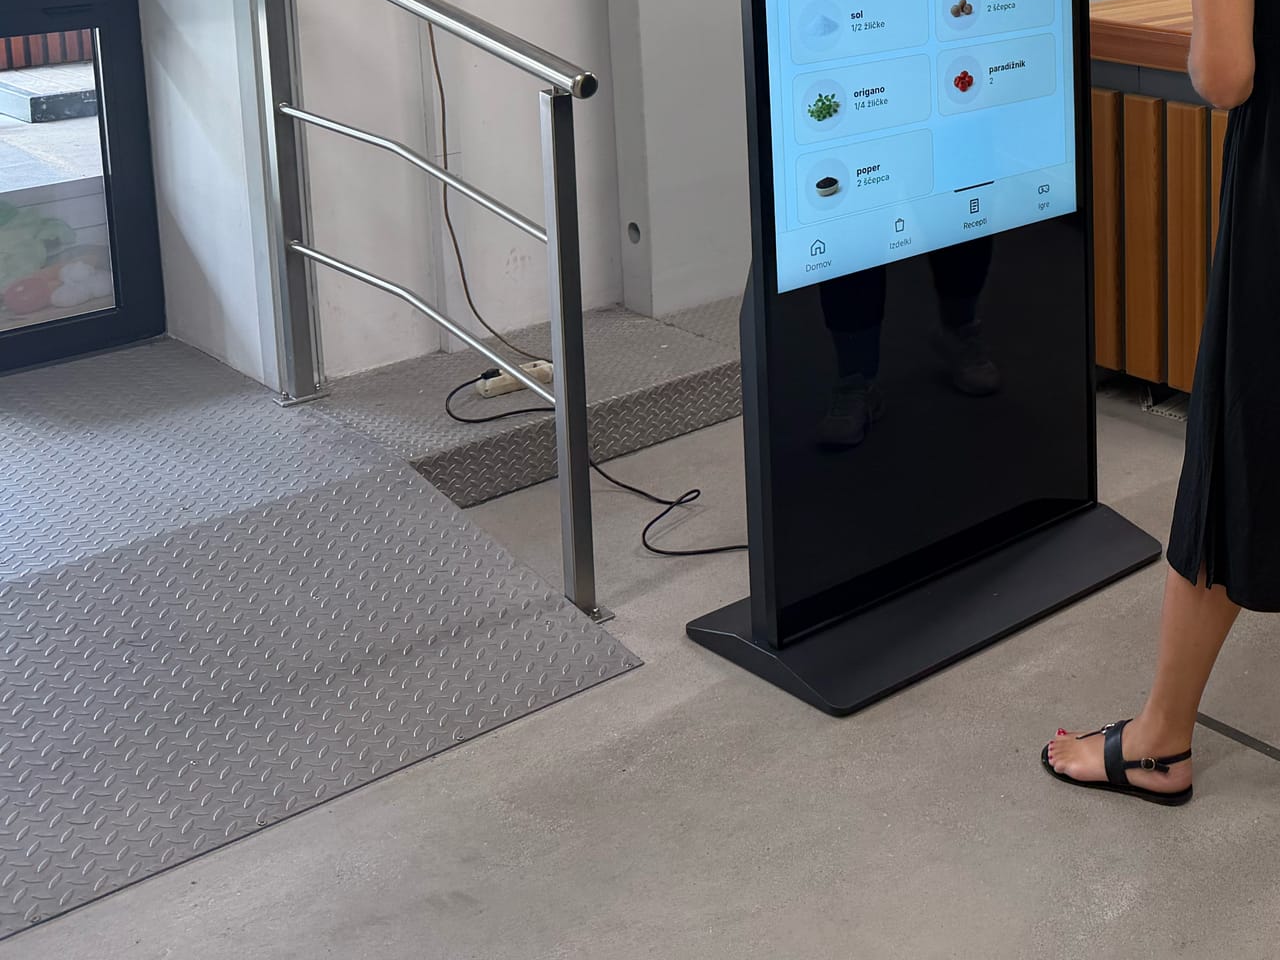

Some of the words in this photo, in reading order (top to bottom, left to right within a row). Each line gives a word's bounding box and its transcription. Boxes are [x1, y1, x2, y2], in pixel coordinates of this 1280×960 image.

[993, 2, 1016, 12] ščepca
[850, 10, 864, 20] sol
[851, 22, 863, 33] 1/2
[863, 20, 886, 31] žličke
[988, 60, 1026, 76] paradižnik
[853, 86, 886, 99] origano
[854, 100, 866, 111] 1/4
[867, 97, 889, 108] žličke
[856, 164, 881, 178] poper
[856, 179, 863, 188] 2
[863, 173, 890, 187] ščepca
[963, 218, 988, 230] Recepti
[889, 236, 912, 250] Izdelki
[805, 259, 833, 273] Domov
